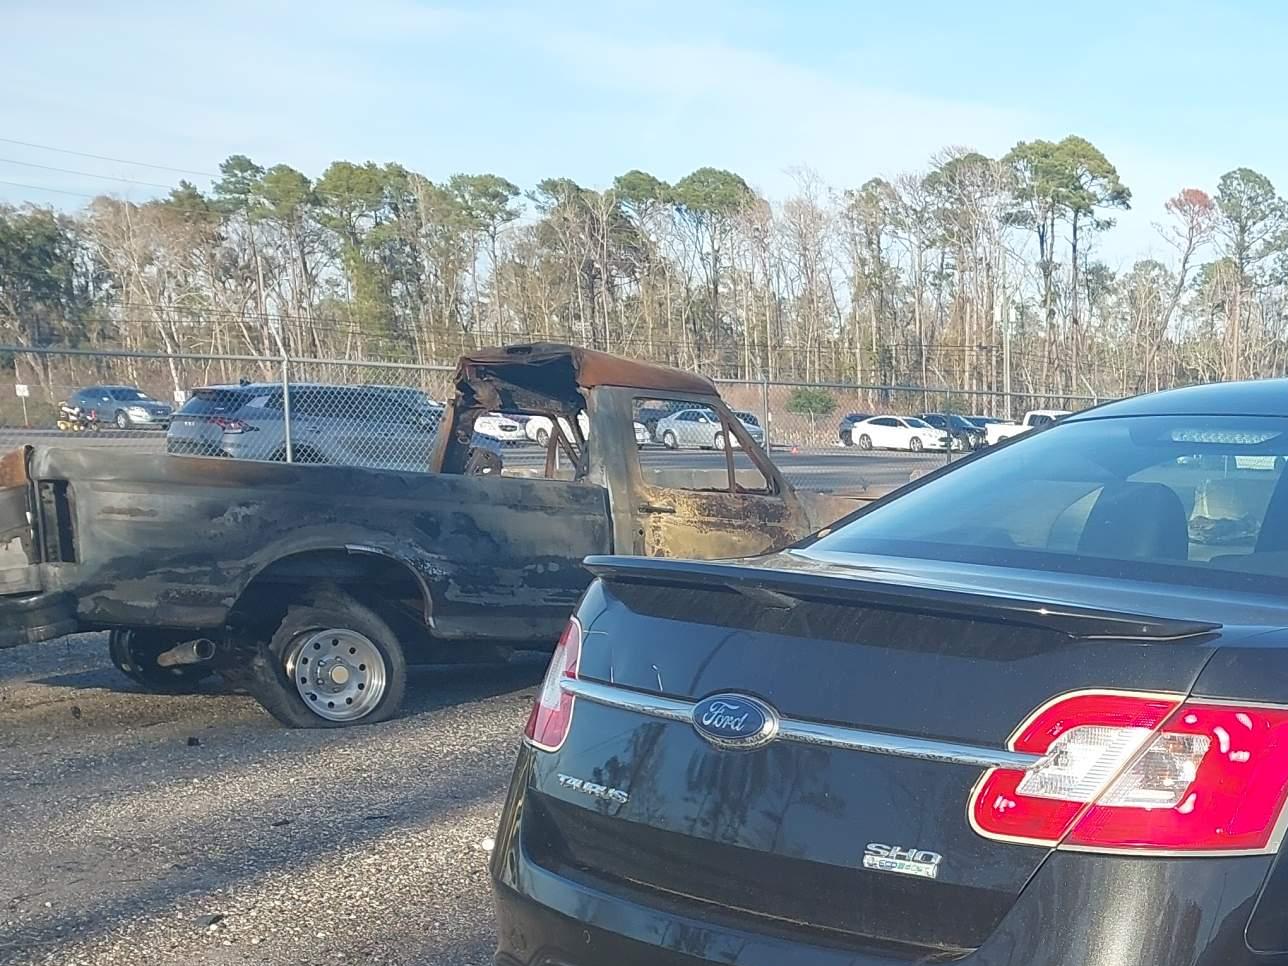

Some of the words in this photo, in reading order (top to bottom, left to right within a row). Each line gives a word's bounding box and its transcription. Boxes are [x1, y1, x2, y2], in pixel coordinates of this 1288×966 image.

[702, 701, 749, 732] Ford
[557, 773, 630, 804] TAURUS
[864, 843, 943, 865] SHO
